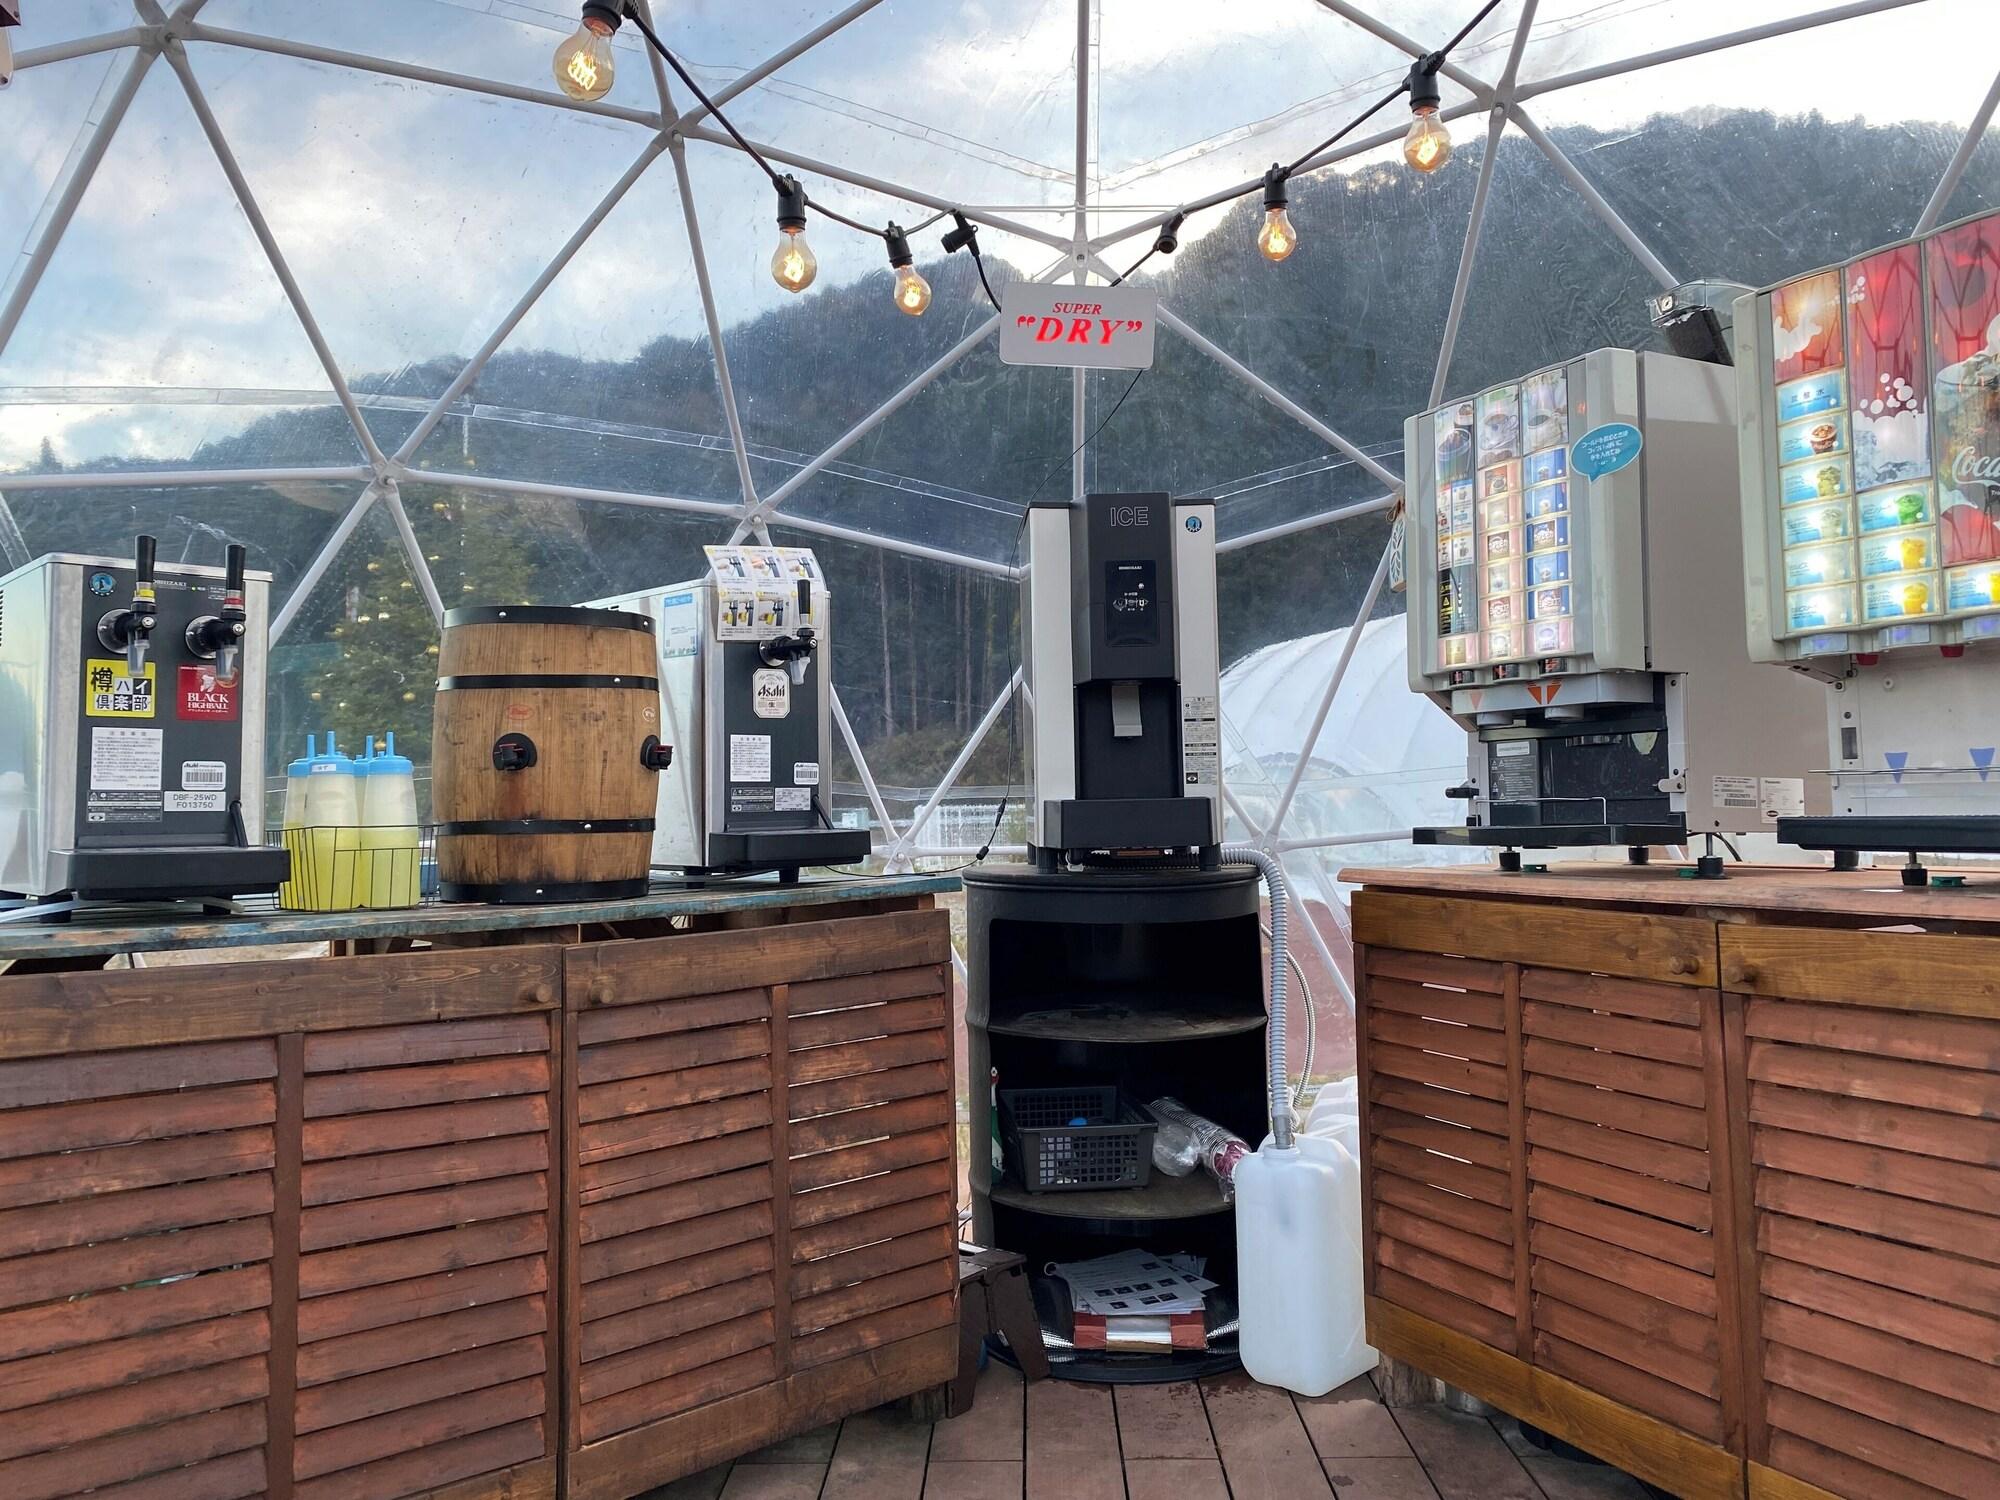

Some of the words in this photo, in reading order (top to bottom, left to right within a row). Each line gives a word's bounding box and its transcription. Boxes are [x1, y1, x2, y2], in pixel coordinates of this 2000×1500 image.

[1052, 302, 1102, 315] SUPER
[1110, 506, 1149, 527] ICE
[757, 684, 786, 697] Asahi
[96, 694, 149, 711] 倶楽部
[187, 692, 229, 703] BLACK
[187, 701, 229, 710] HIGHBALL
[173, 793, 217, 801] DBF-25WD
